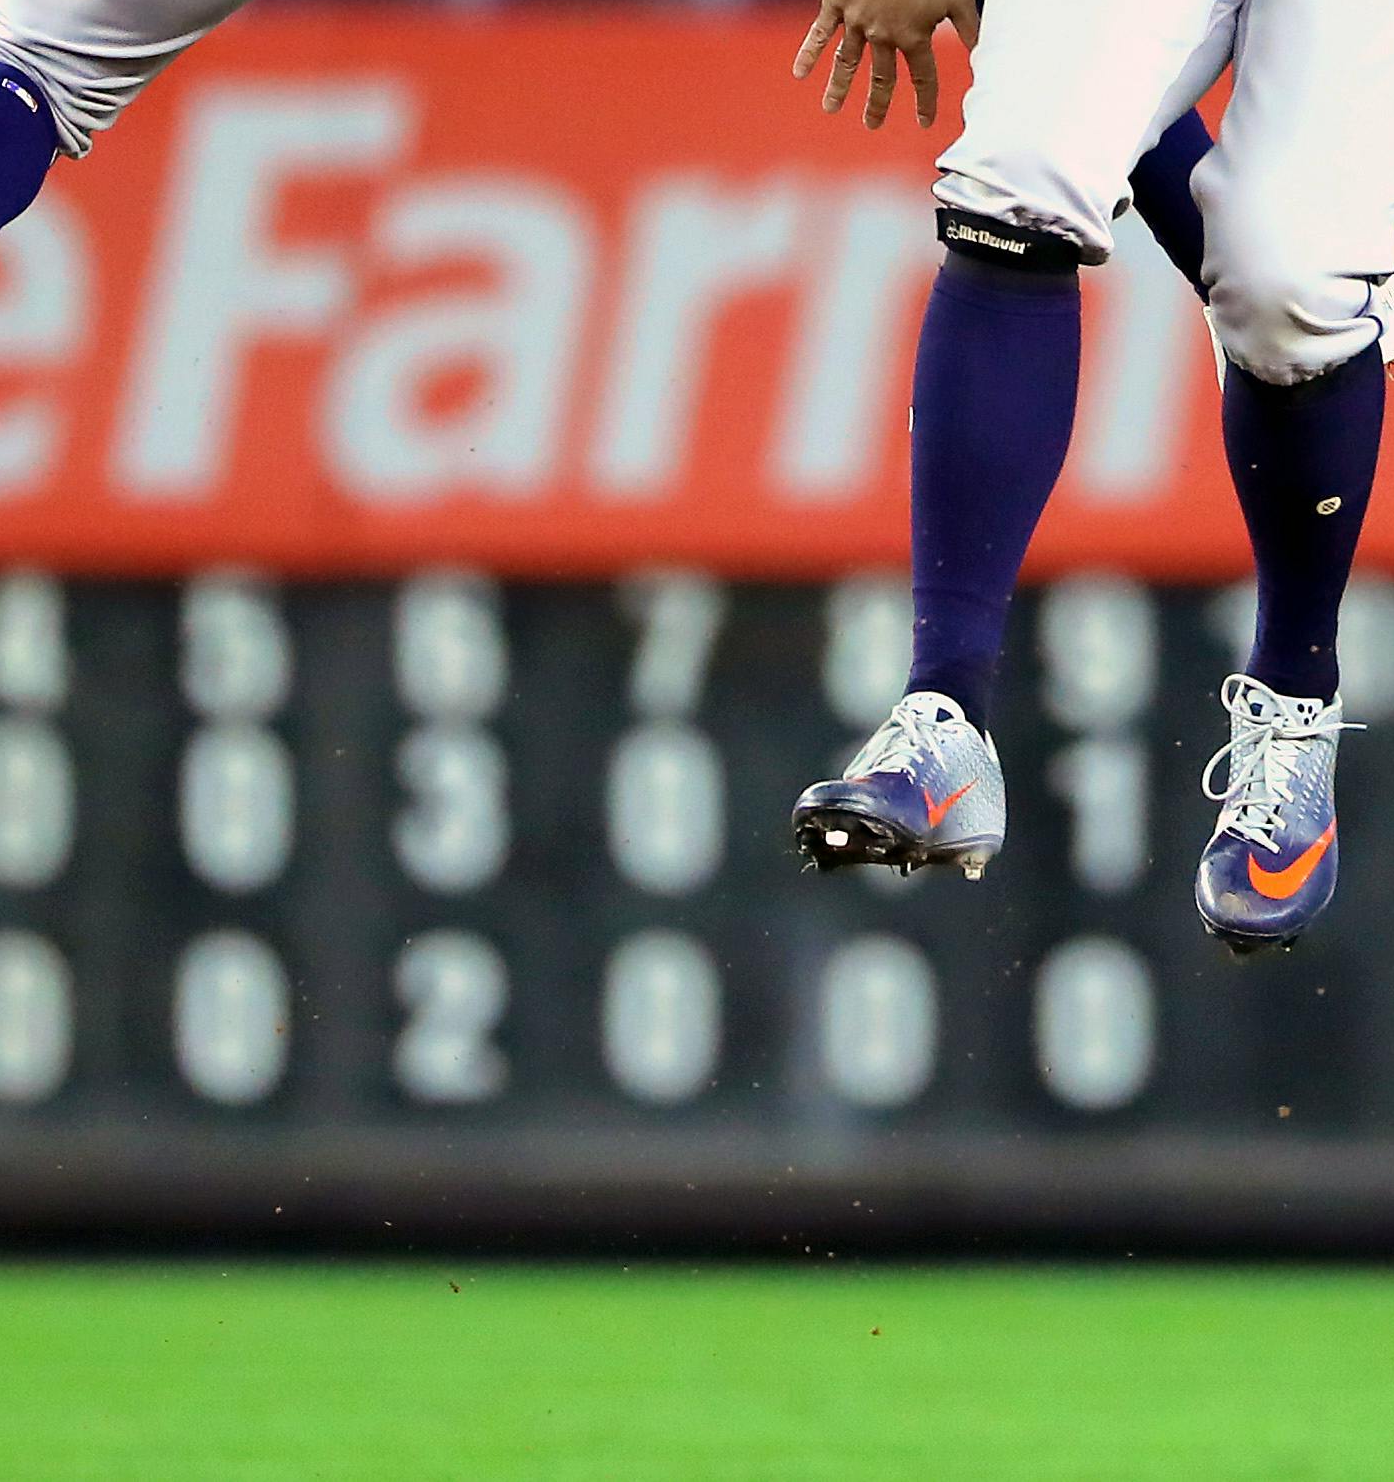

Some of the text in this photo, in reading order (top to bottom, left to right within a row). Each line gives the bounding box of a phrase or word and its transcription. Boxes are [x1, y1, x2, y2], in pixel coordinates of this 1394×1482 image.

[397, 720, 507, 889] 3
[1053, 730, 1151, 890] 1
[396, 932, 505, 1101] 2
